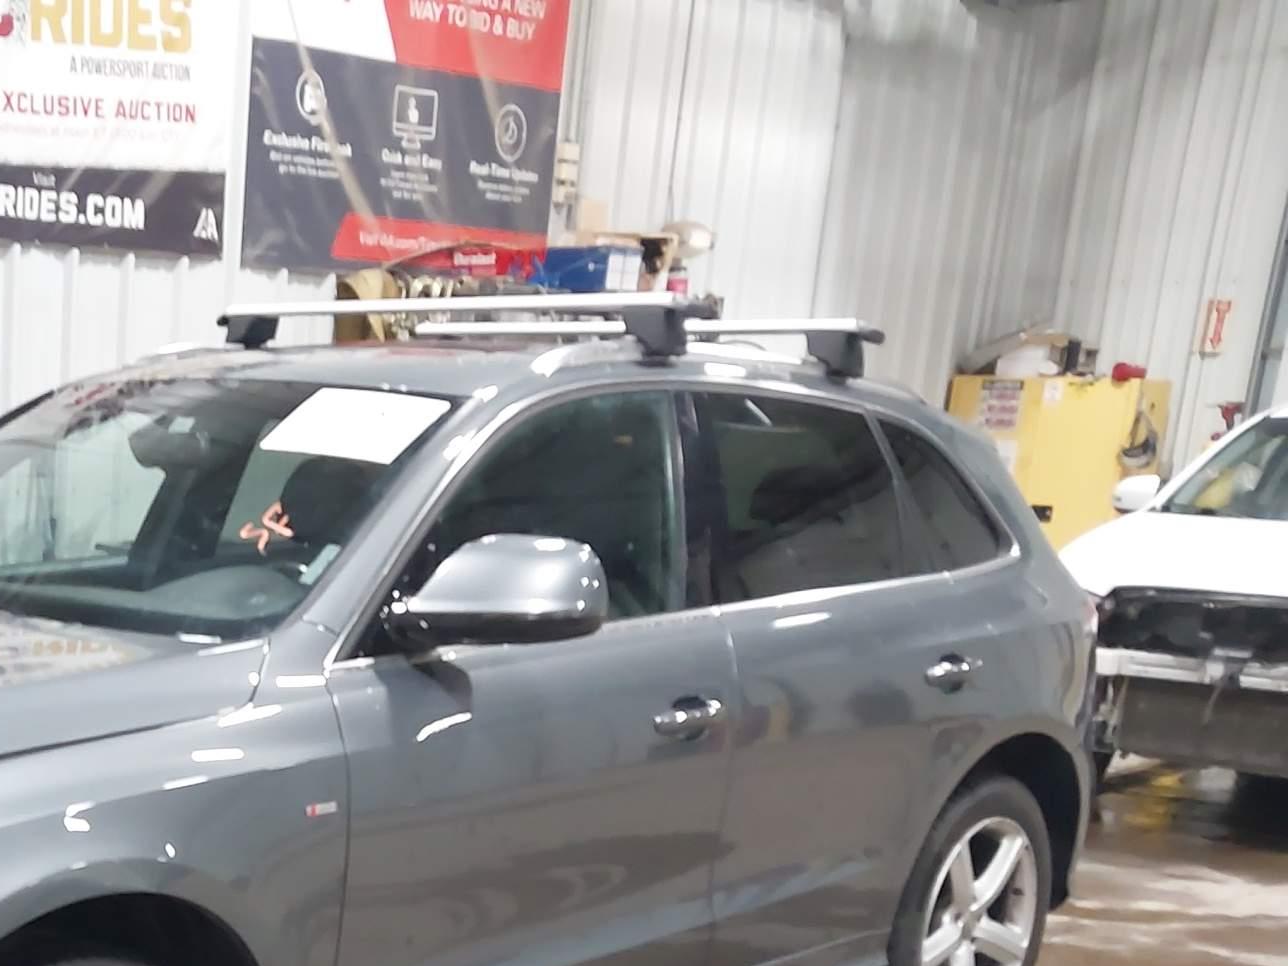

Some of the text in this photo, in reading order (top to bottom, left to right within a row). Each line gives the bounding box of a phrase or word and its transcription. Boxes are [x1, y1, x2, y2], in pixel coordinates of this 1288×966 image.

[409, 0, 444, 23] WAY
[447, 3, 468, 28] TO
[69, 55, 191, 82] A POWERSPORT AUCTION
[115, 99, 197, 123] AUCTION
